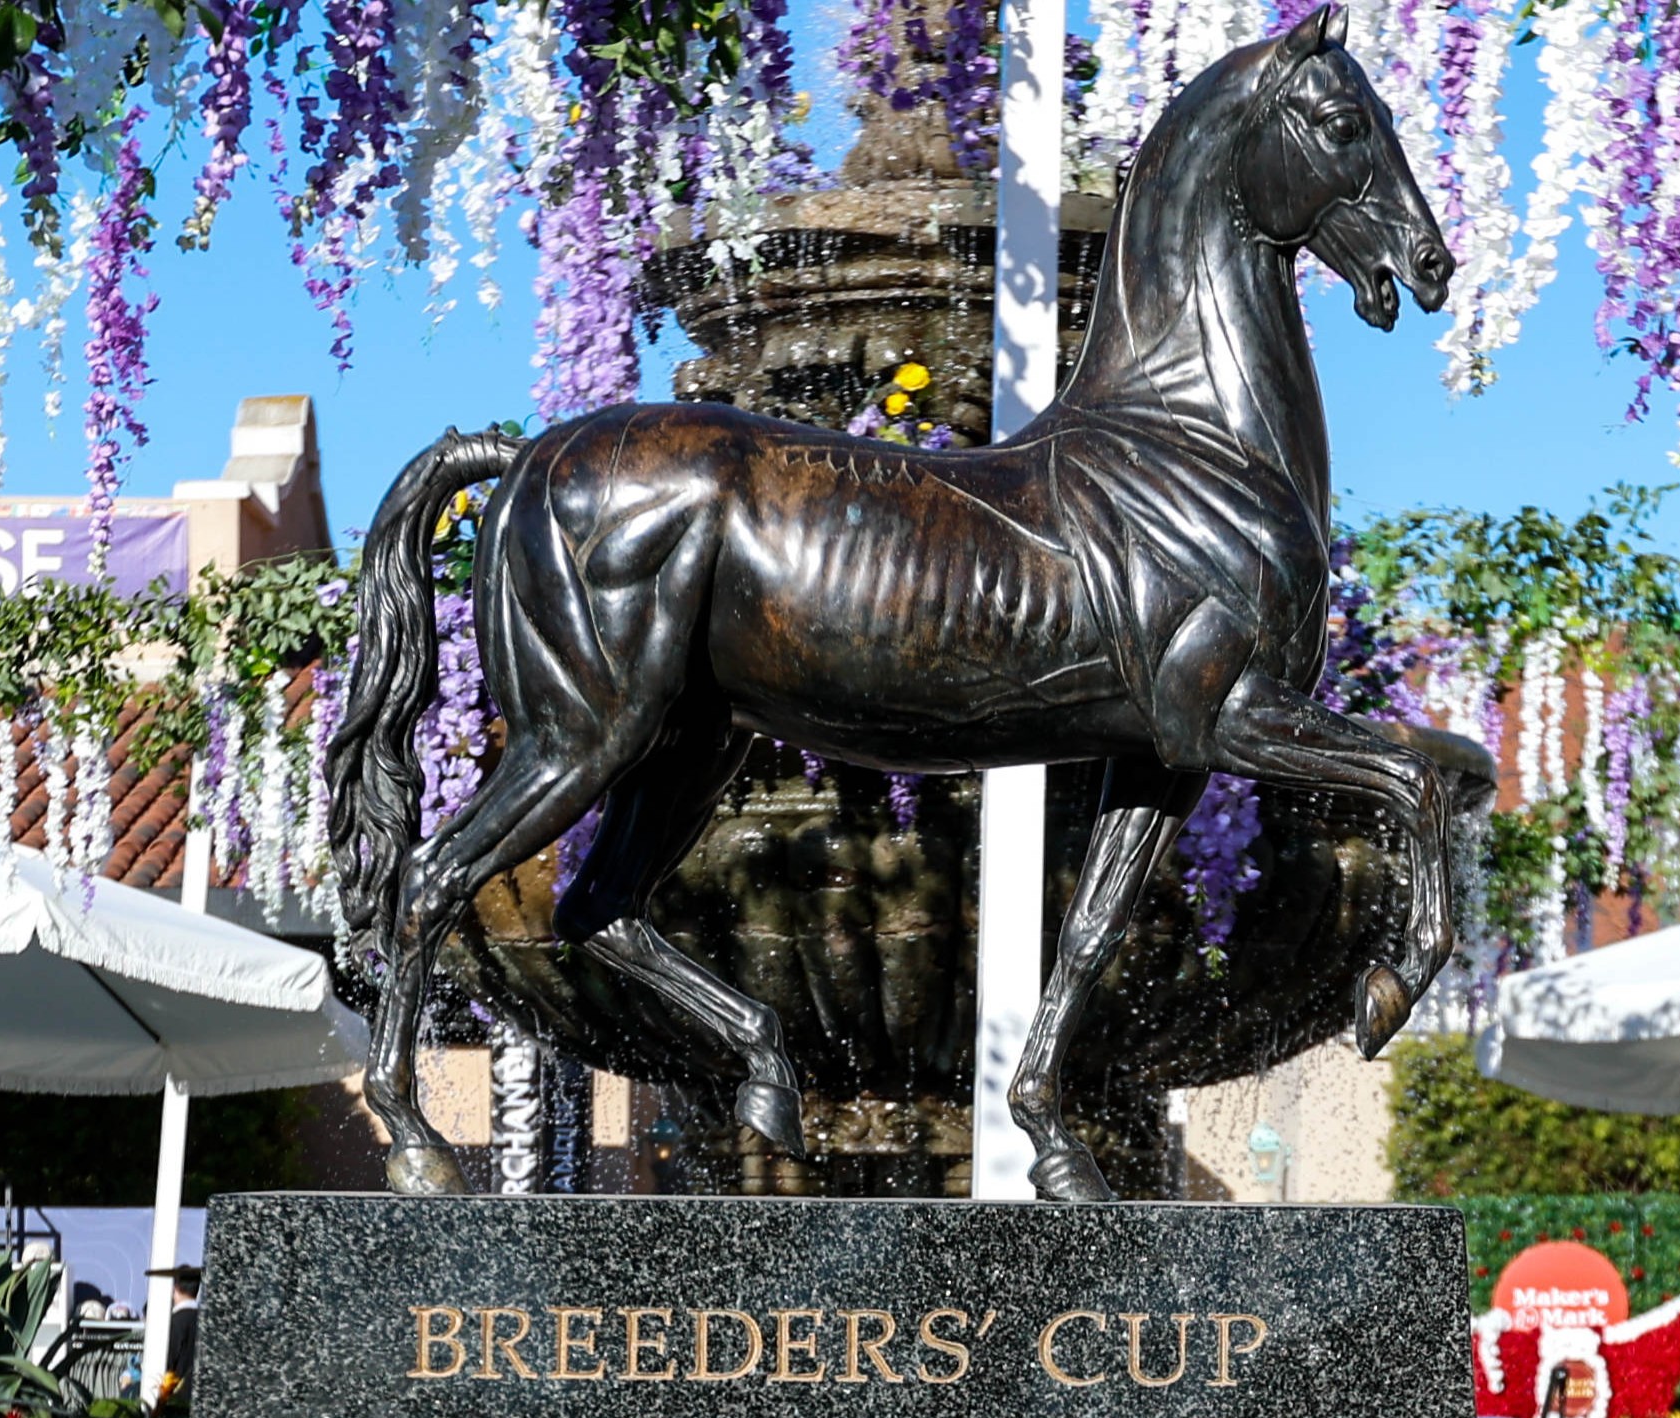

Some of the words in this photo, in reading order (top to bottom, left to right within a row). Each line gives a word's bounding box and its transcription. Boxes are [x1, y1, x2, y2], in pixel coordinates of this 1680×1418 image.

[1512, 1287, 1610, 1306] Maker's
[1541, 1307, 1610, 1327] Mark
[405, 1305, 995, 1384] BREEDERS'
[1037, 1309, 1267, 1387] CUP
